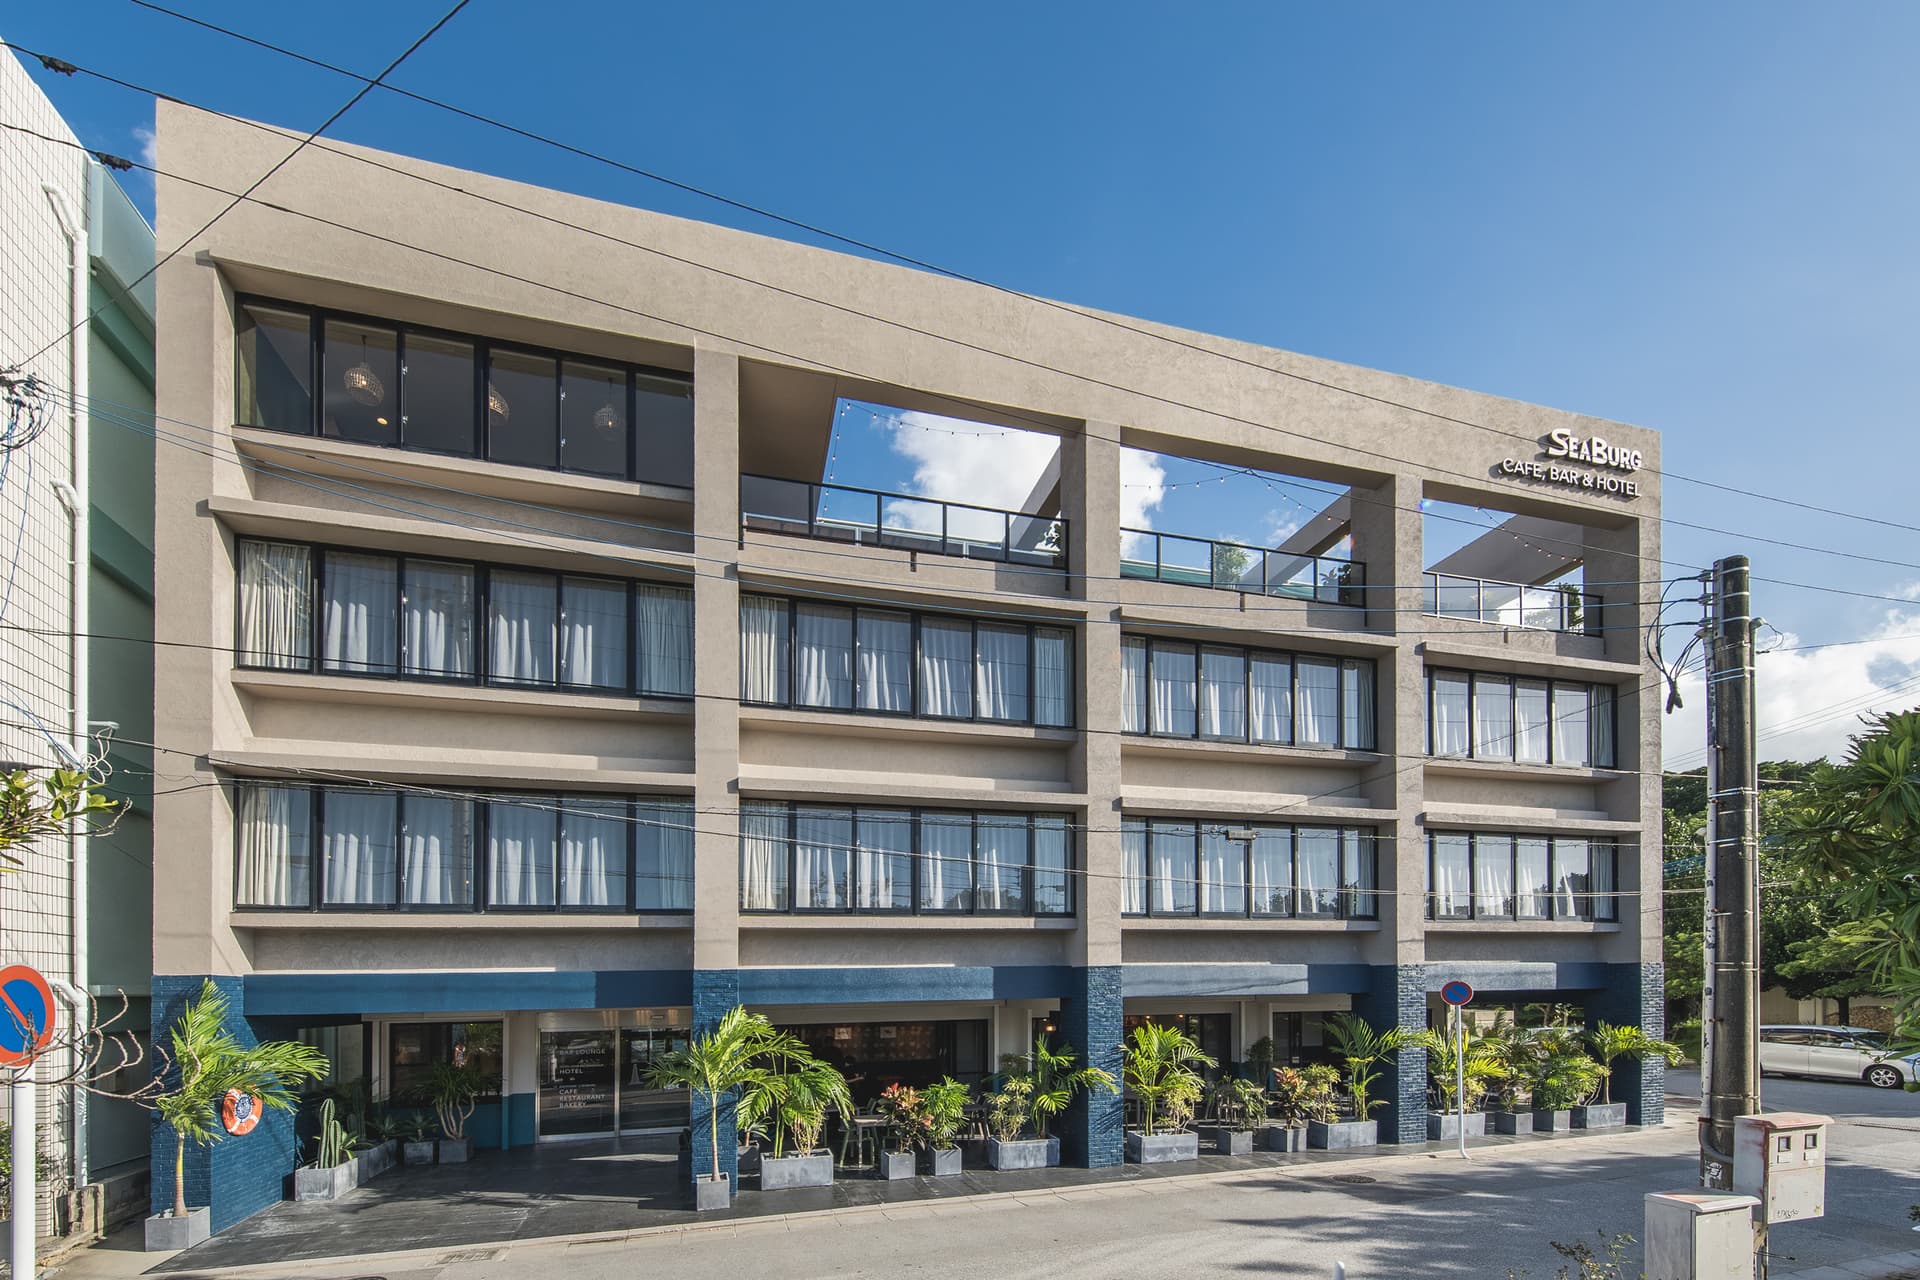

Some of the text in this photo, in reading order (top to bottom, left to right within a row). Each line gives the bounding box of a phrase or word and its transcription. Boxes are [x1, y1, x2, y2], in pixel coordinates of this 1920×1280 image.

[1502, 457, 1642, 497] CAFE, BAR & HOTEL
